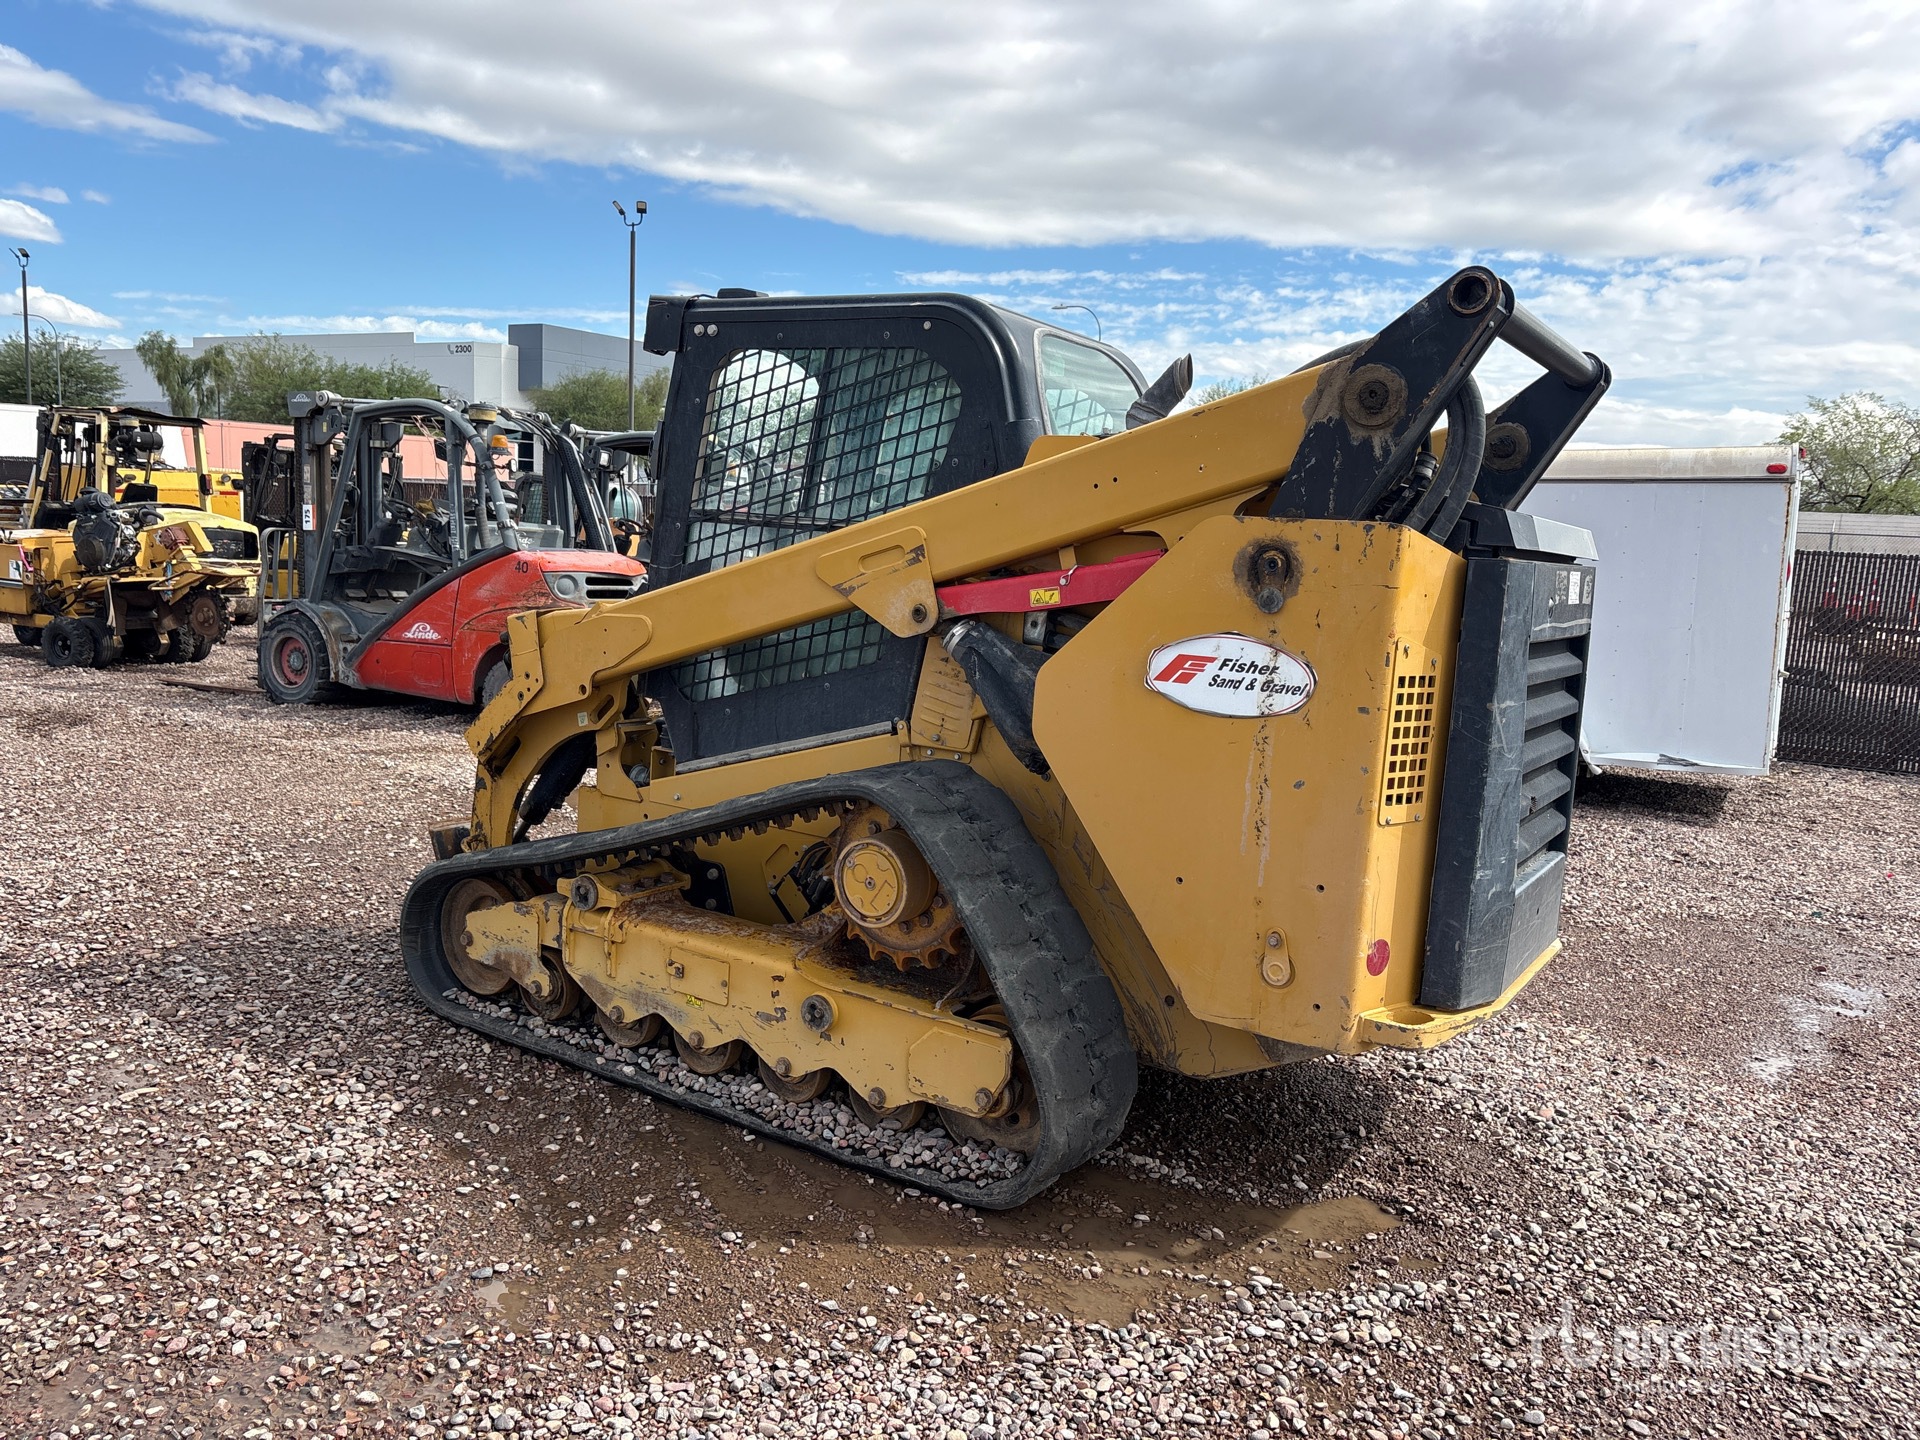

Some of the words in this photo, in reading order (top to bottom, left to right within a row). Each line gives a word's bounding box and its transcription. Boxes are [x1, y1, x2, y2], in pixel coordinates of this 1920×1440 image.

[455, 344, 472, 353] 2300
[514, 560, 529, 574] 40
[402, 622, 442, 640] Linde
[1218, 658, 1280, 676] Fisher
[1208, 674, 1245, 690] Sand
[1245, 678, 1258, 691] &
[1260, 680, 1309, 697] Gravel
